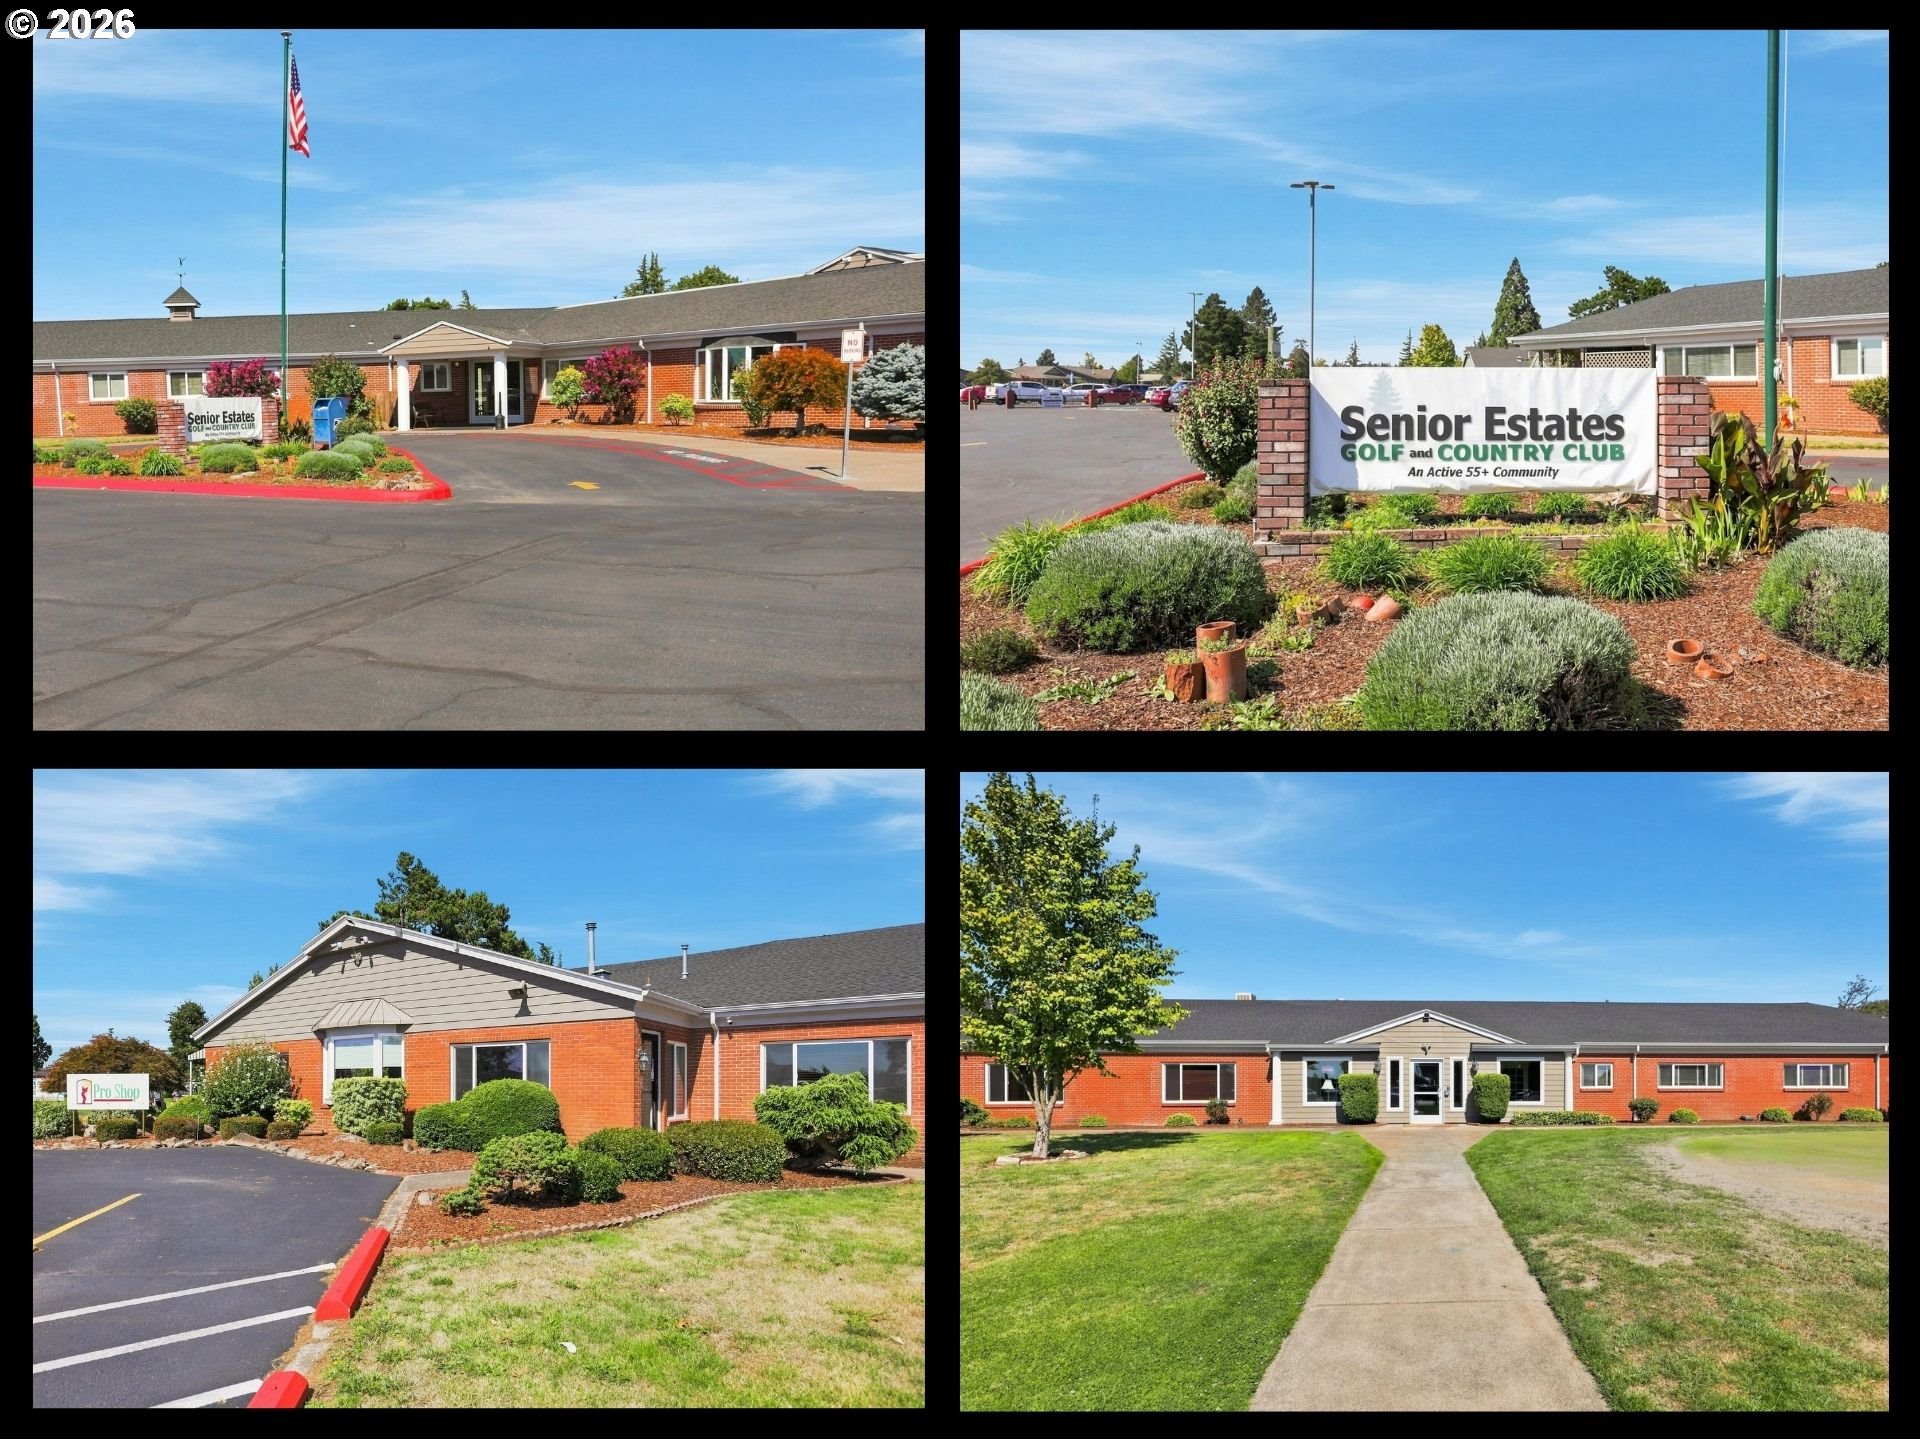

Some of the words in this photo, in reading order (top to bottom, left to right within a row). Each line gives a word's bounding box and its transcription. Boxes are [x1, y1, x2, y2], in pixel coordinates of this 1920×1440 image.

[187, 411, 220, 425] Senior
[222, 411, 255, 423] Estates
[1339, 405, 1471, 442] Senior
[1484, 406, 1625, 442] Estates
[1340, 443, 1404, 463] GOLF
[1409, 447, 1433, 459] and
[1438, 443, 1552, 462] COUNTRY
[1562, 443, 1625, 462] CLUB
[1408, 466, 1424, 478] An
[1427, 466, 1462, 478] Active
[1465, 466, 1489, 478] 55+
[1493, 466, 1559, 479] Community
[93, 1083, 111, 1098] Pro
[114, 1083, 139, 1100] Shop
